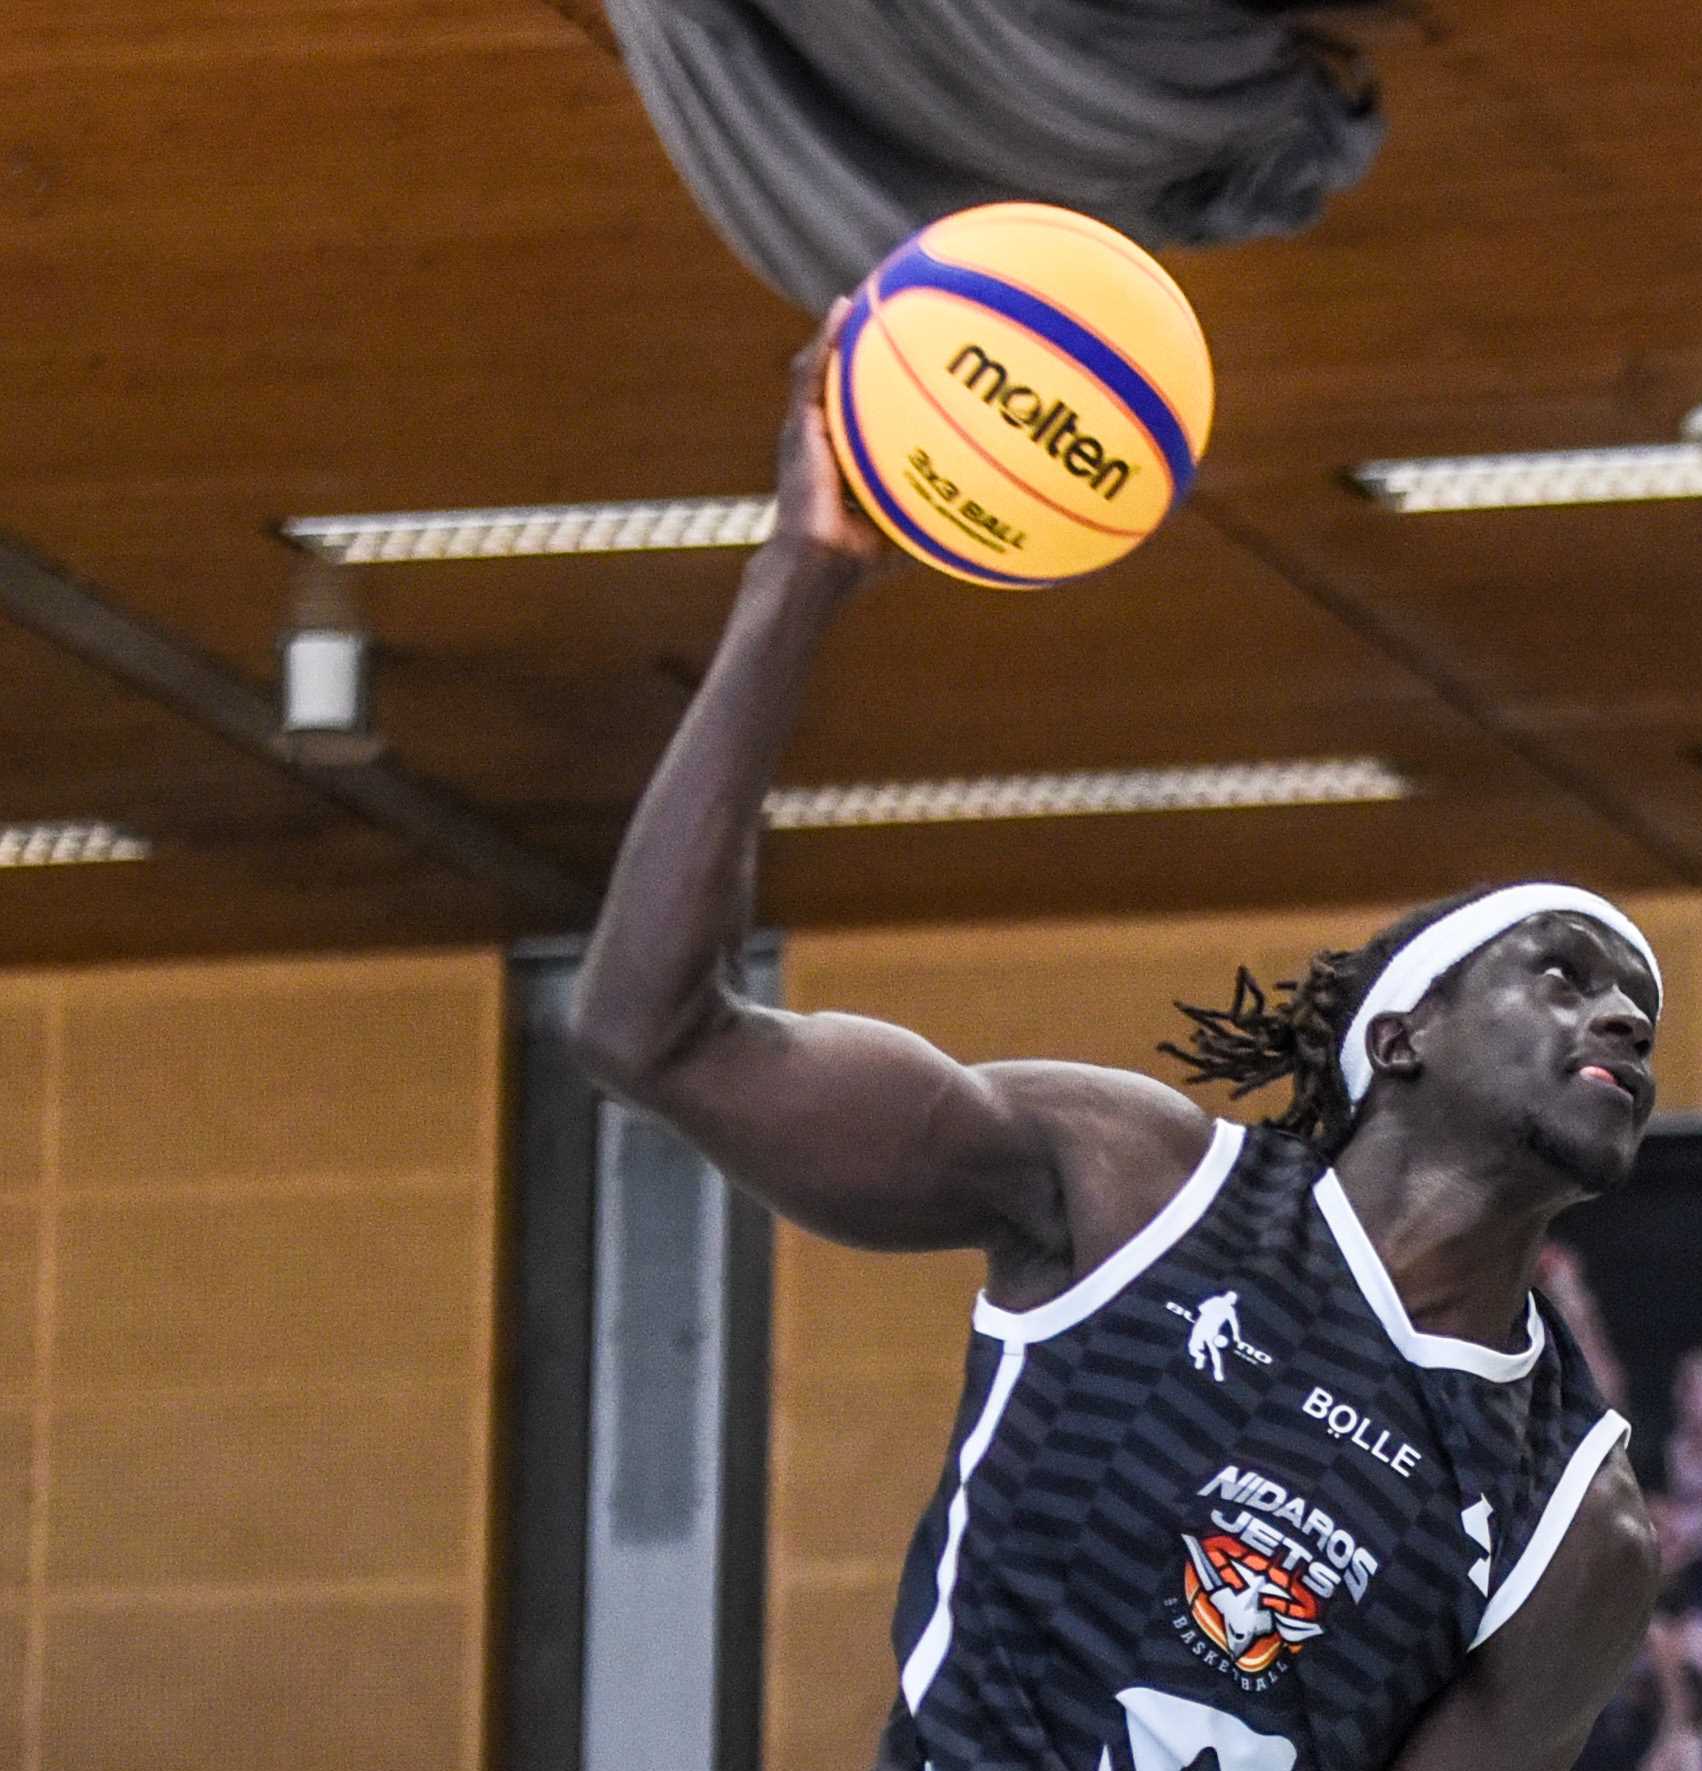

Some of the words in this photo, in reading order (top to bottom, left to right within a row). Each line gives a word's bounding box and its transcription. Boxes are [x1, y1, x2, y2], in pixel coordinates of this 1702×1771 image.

[944, 344, 1133, 502] molten
[908, 448, 960, 503] 3x3
[959, 500, 1026, 551] BALL
[1197, 1465, 1378, 1606] NIDAROS
[1210, 1508, 1342, 1599] JETS
